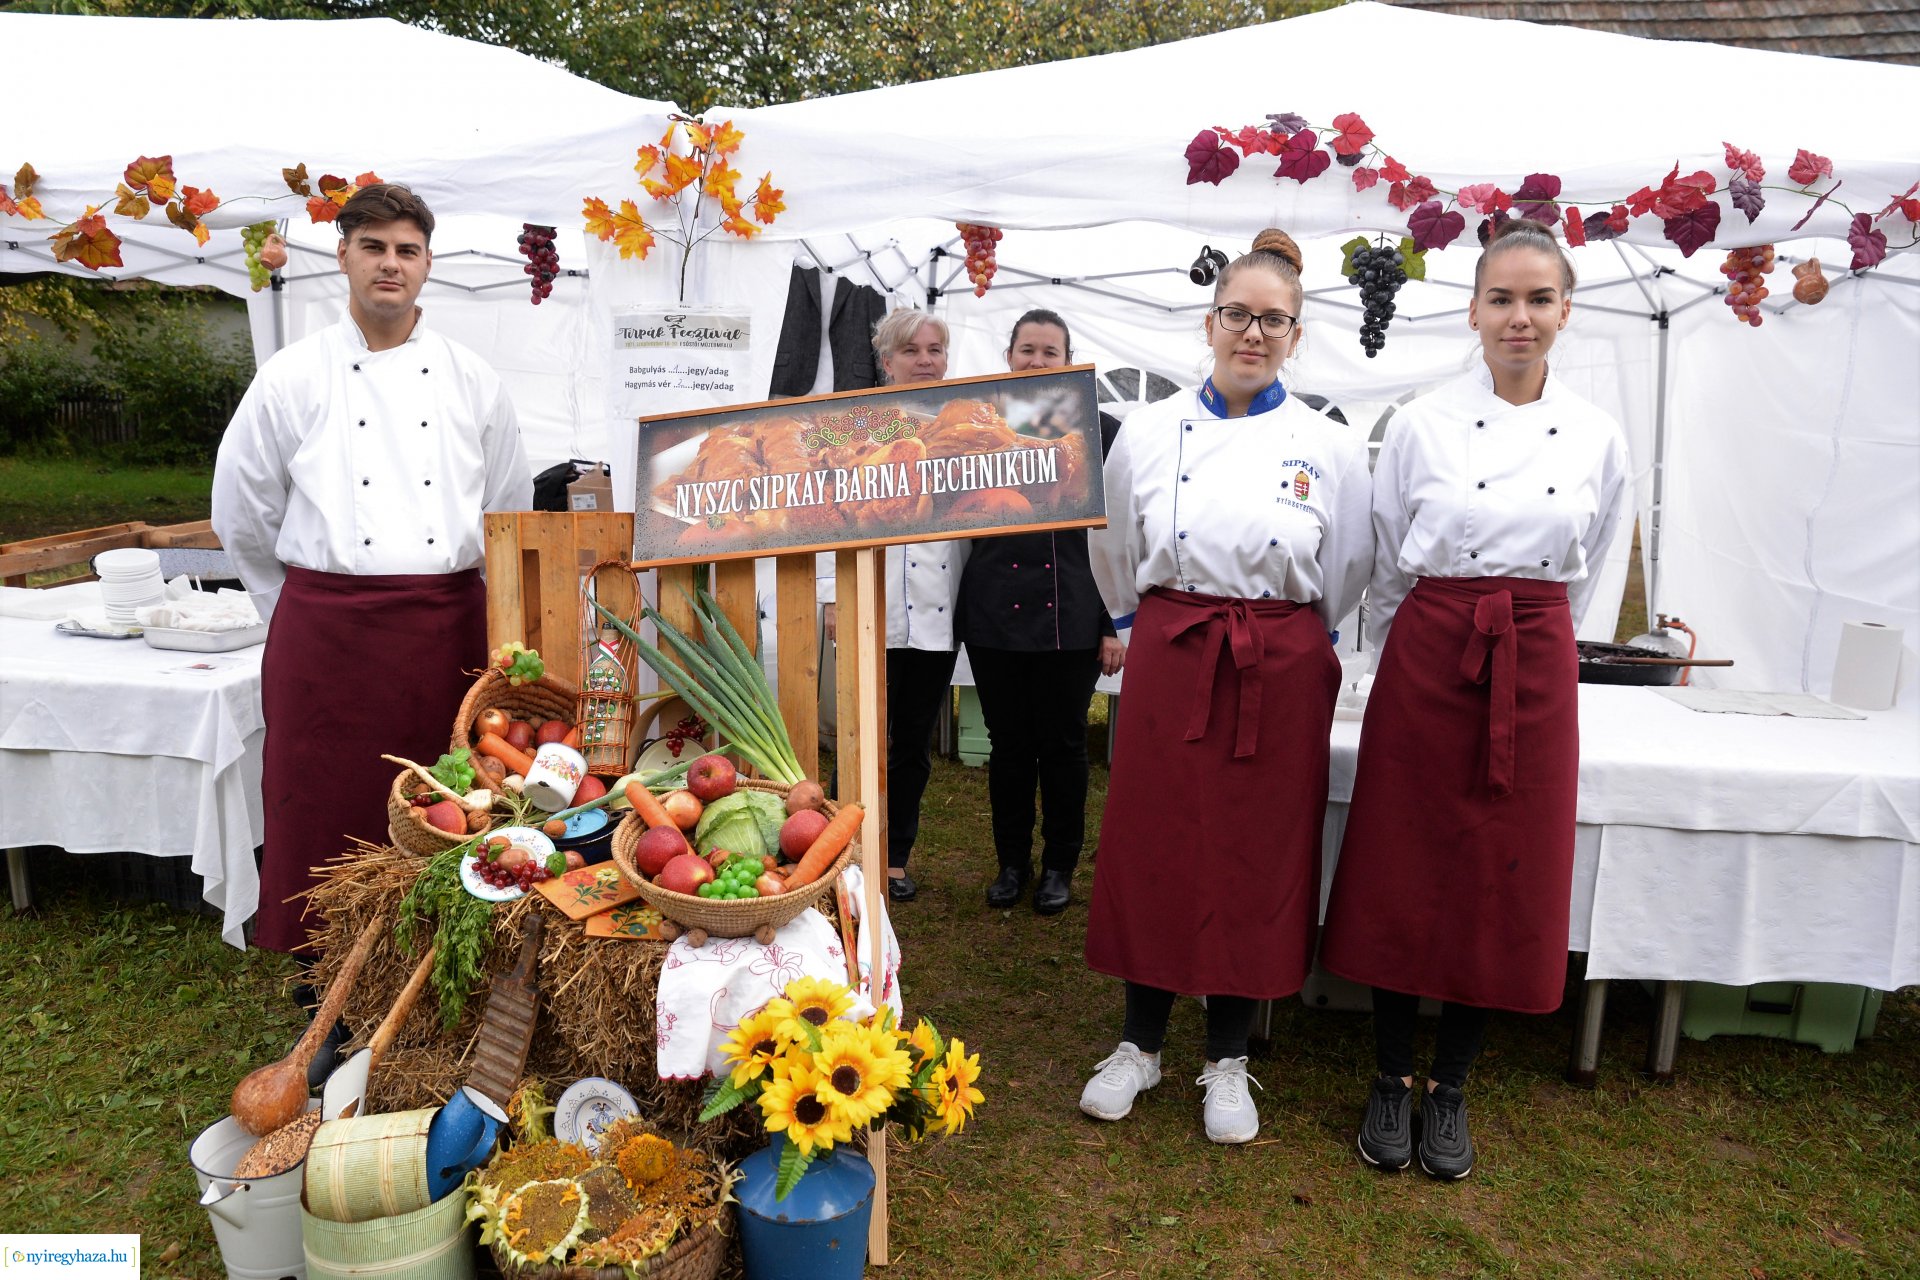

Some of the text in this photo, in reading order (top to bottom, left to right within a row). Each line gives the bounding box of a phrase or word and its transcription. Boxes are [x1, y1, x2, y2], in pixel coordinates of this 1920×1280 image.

[616, 326, 746, 341] Tirpák Fesztivál
[629, 365, 666, 375] Babgulyás
[624, 380, 656, 389] Hagymás
[658, 379, 672, 388] vér
[1281, 459, 1320, 480] SIPKAY
[675, 447, 1059, 518] NYSZC SIPKAY BARNA TECHNIKUM
